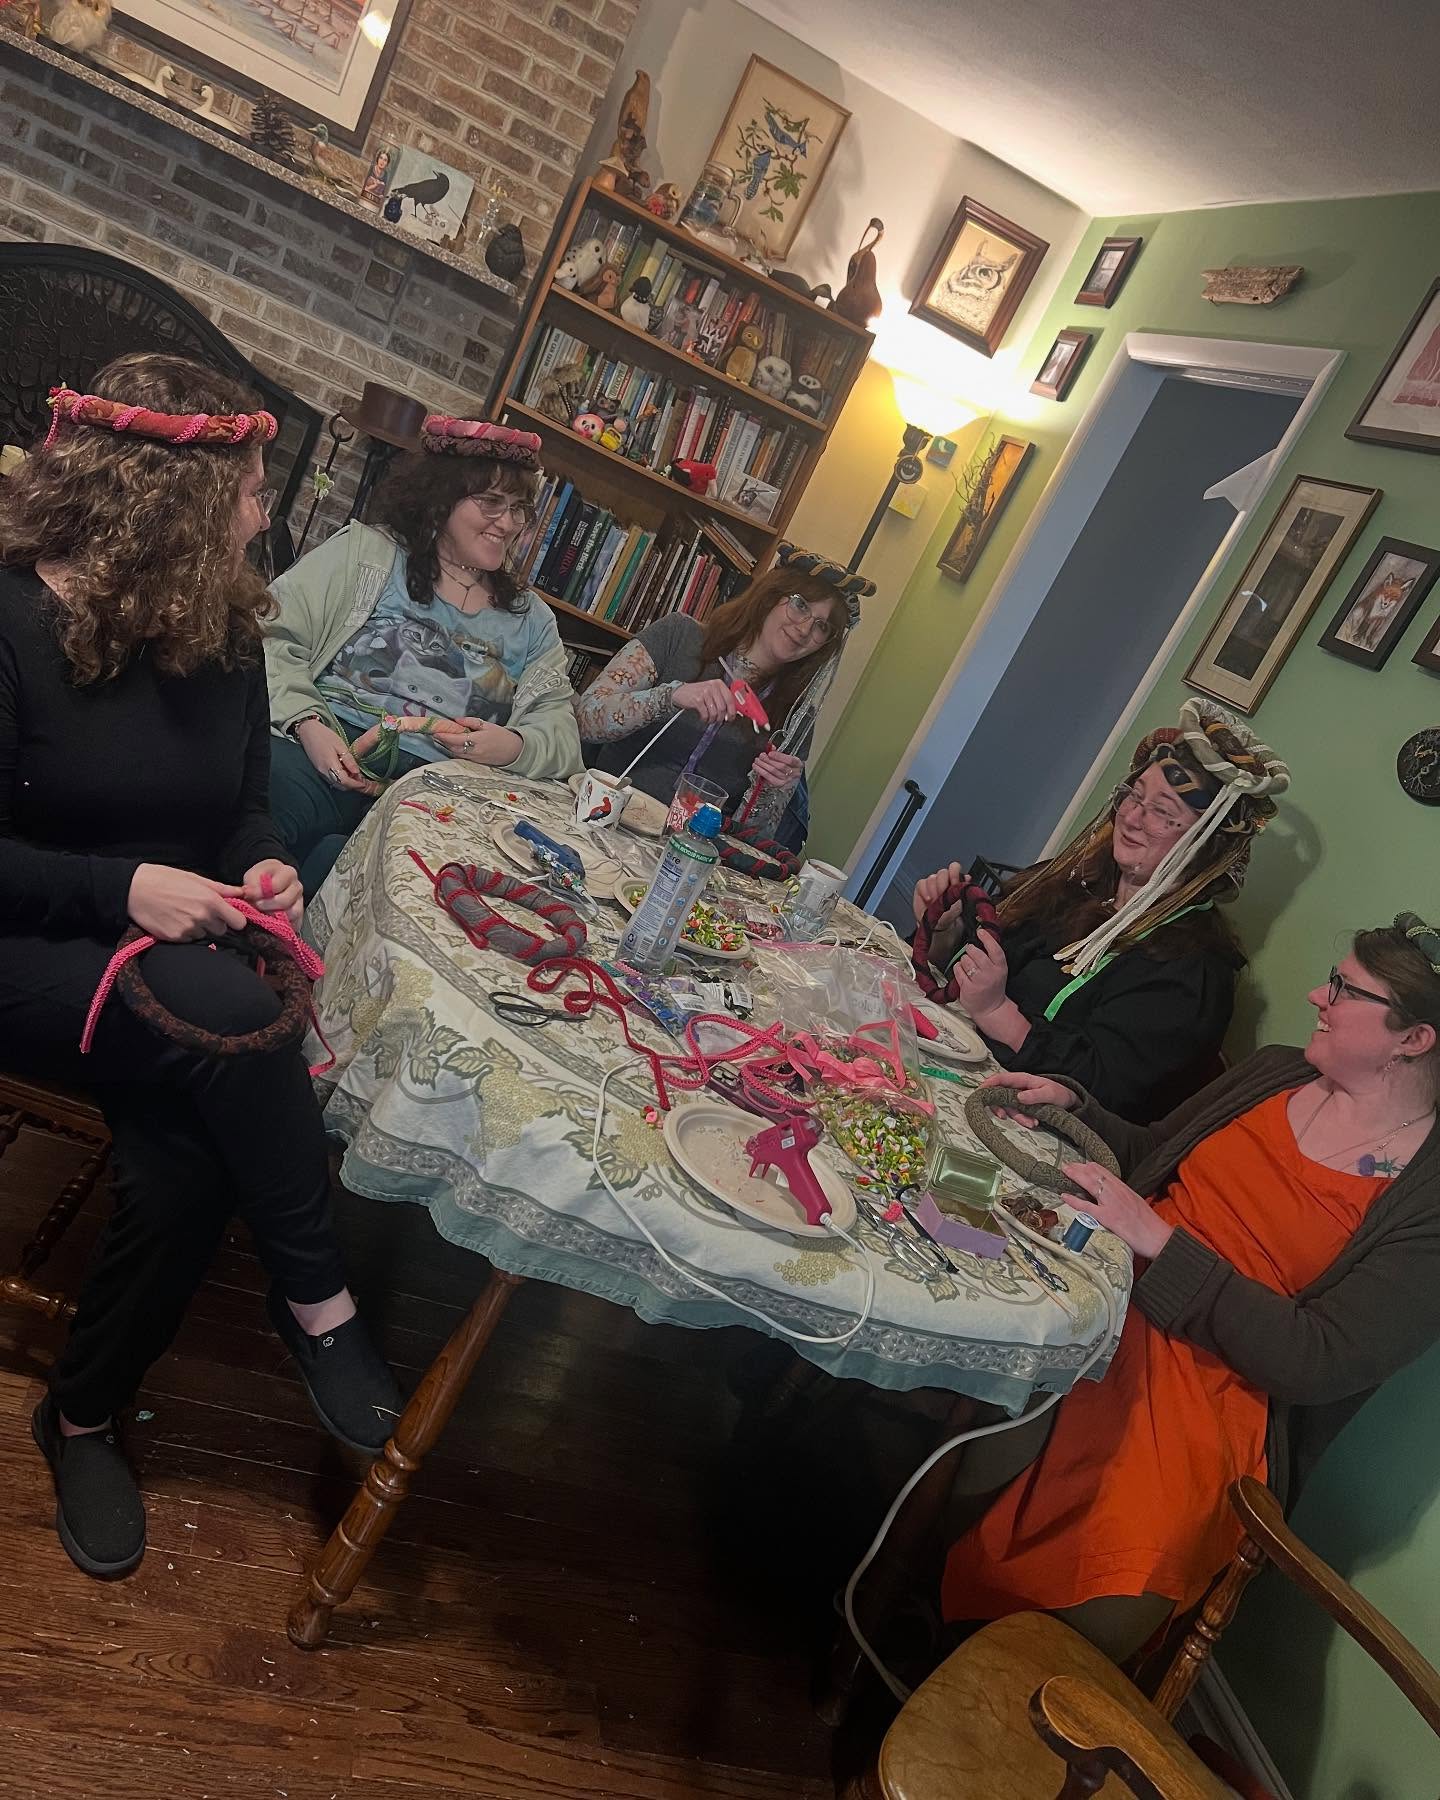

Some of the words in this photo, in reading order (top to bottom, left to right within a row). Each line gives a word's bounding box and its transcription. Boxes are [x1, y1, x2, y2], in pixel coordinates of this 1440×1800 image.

[549, 342, 557, 353] CAN
[589, 520, 604, 540] Save
[583, 538, 596, 554] the
[558, 546, 577, 577] BIRDS
[574, 551, 589, 573] Birds
[670, 813, 683, 829] IPA
